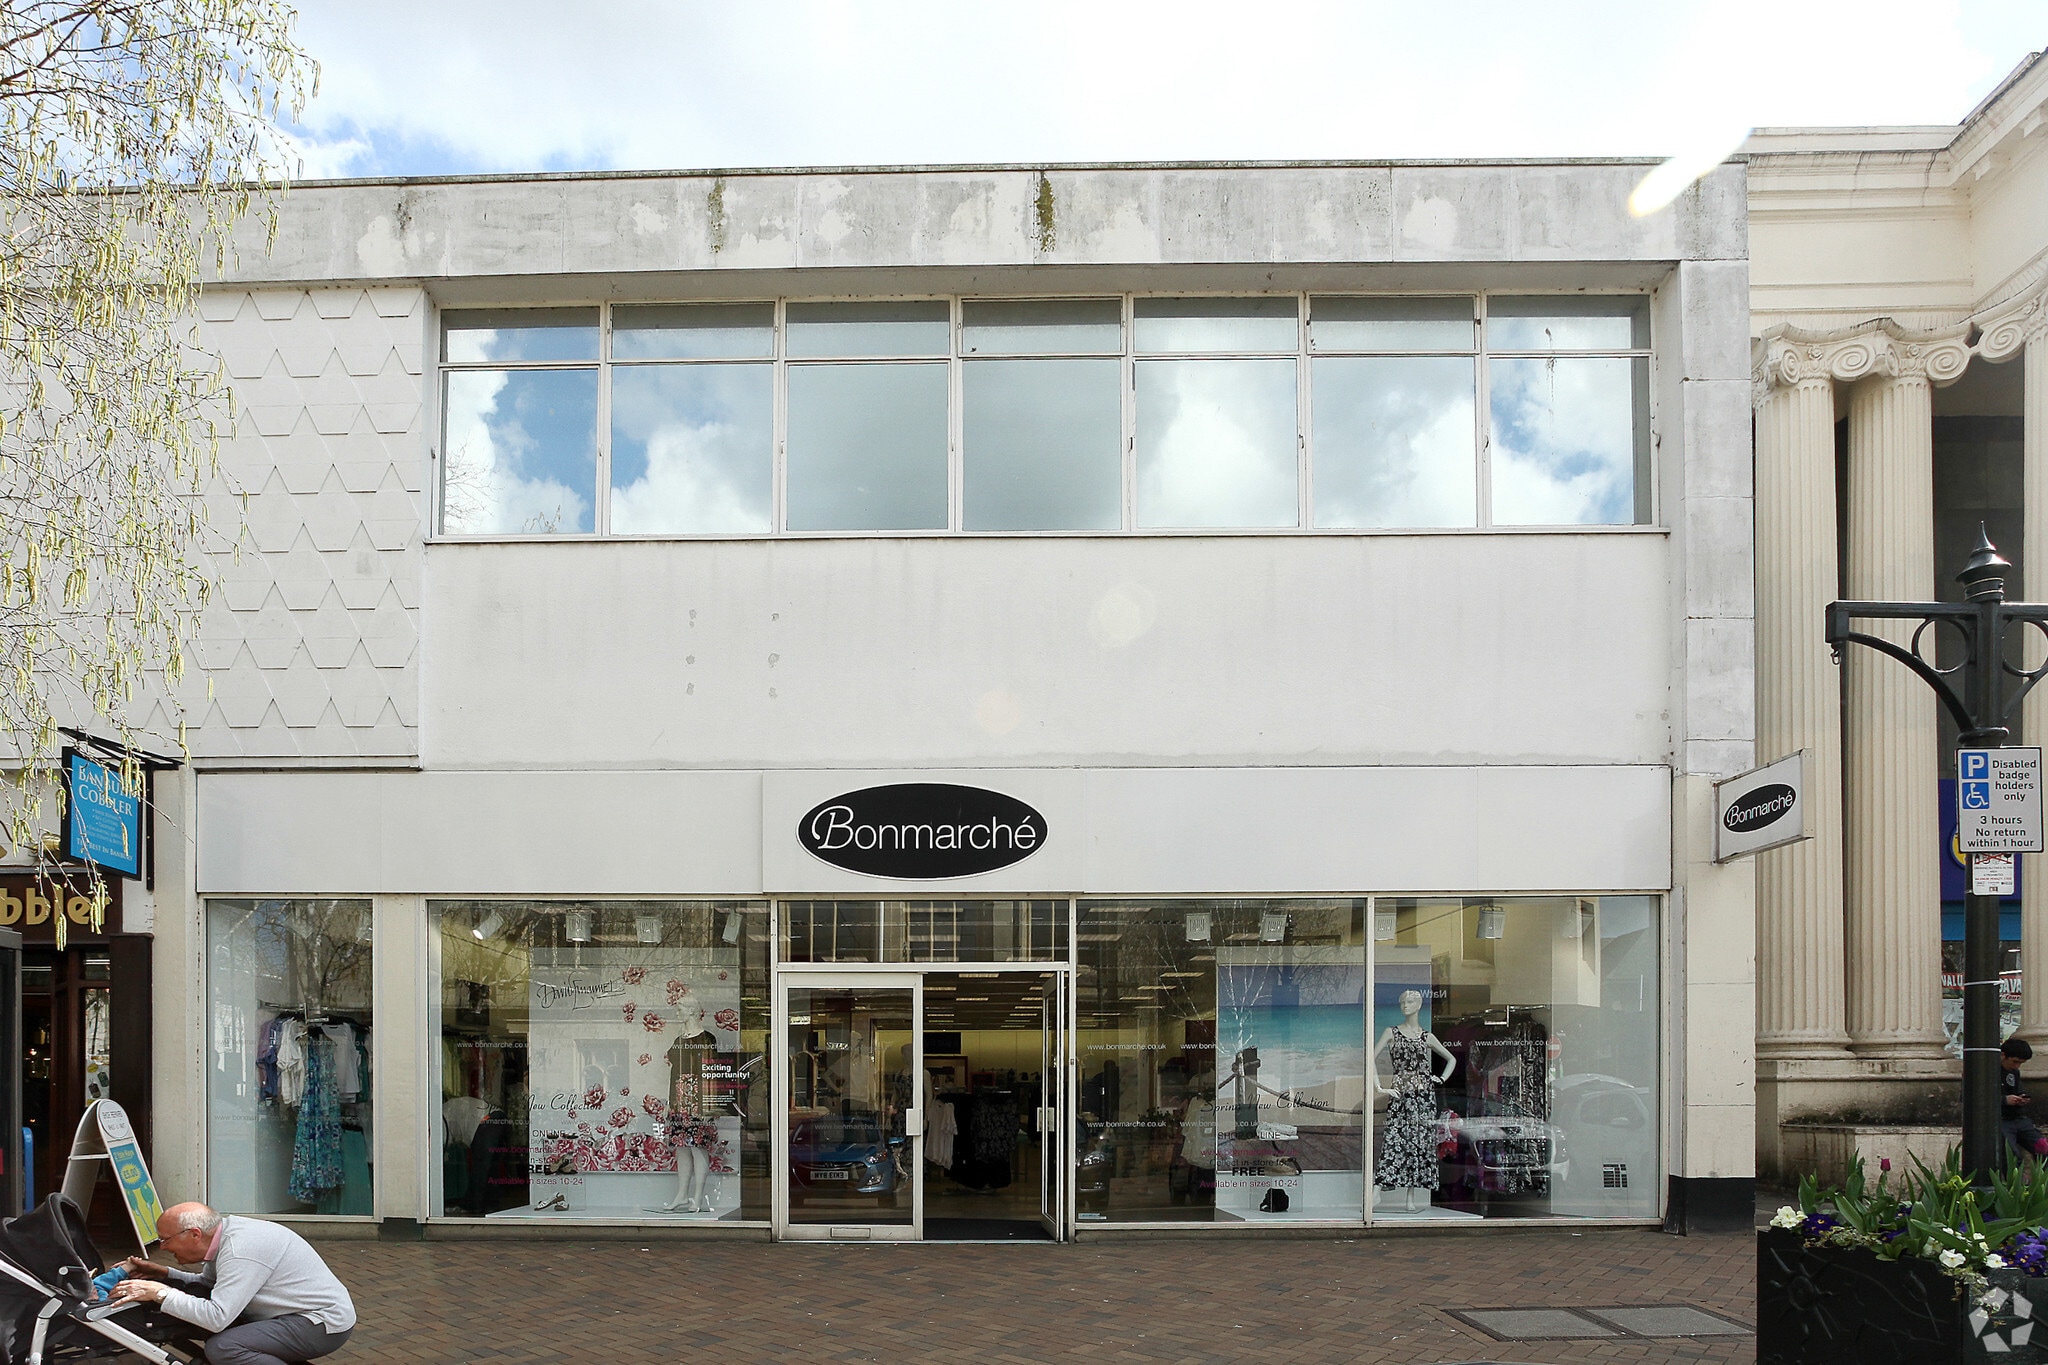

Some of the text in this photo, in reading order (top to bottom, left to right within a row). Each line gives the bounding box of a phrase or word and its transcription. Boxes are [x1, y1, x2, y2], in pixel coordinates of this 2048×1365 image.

[1967, 755, 1985, 777] P
[1992, 760, 2037, 769] Disabled
[1999, 771, 2030, 780] badge
[79, 765, 137, 799] BANU
[1995, 781, 2034, 790] holders
[2003, 792, 2026, 801] only
[1726, 790, 1793, 827] Bonmarché
[1980, 816, 2022, 824] 3 hours
[812, 805, 1036, 850] Bonmarché
[1975, 828, 1990, 836] No
[1967, 839, 2034, 847] within 1 hour
[1475, 1038, 1550, 1047] www.bonmarche.co.u
[702, 1064, 731, 1072] Exciting
[702, 1071, 750, 1080] opportunity!
[1276, 1091, 1330, 1109] Collection
[527, 1164, 550, 1174] REE
[1232, 1166, 1265, 1176] FREE
[1200, 1179, 1298, 1188] Available in sizes 10-24
